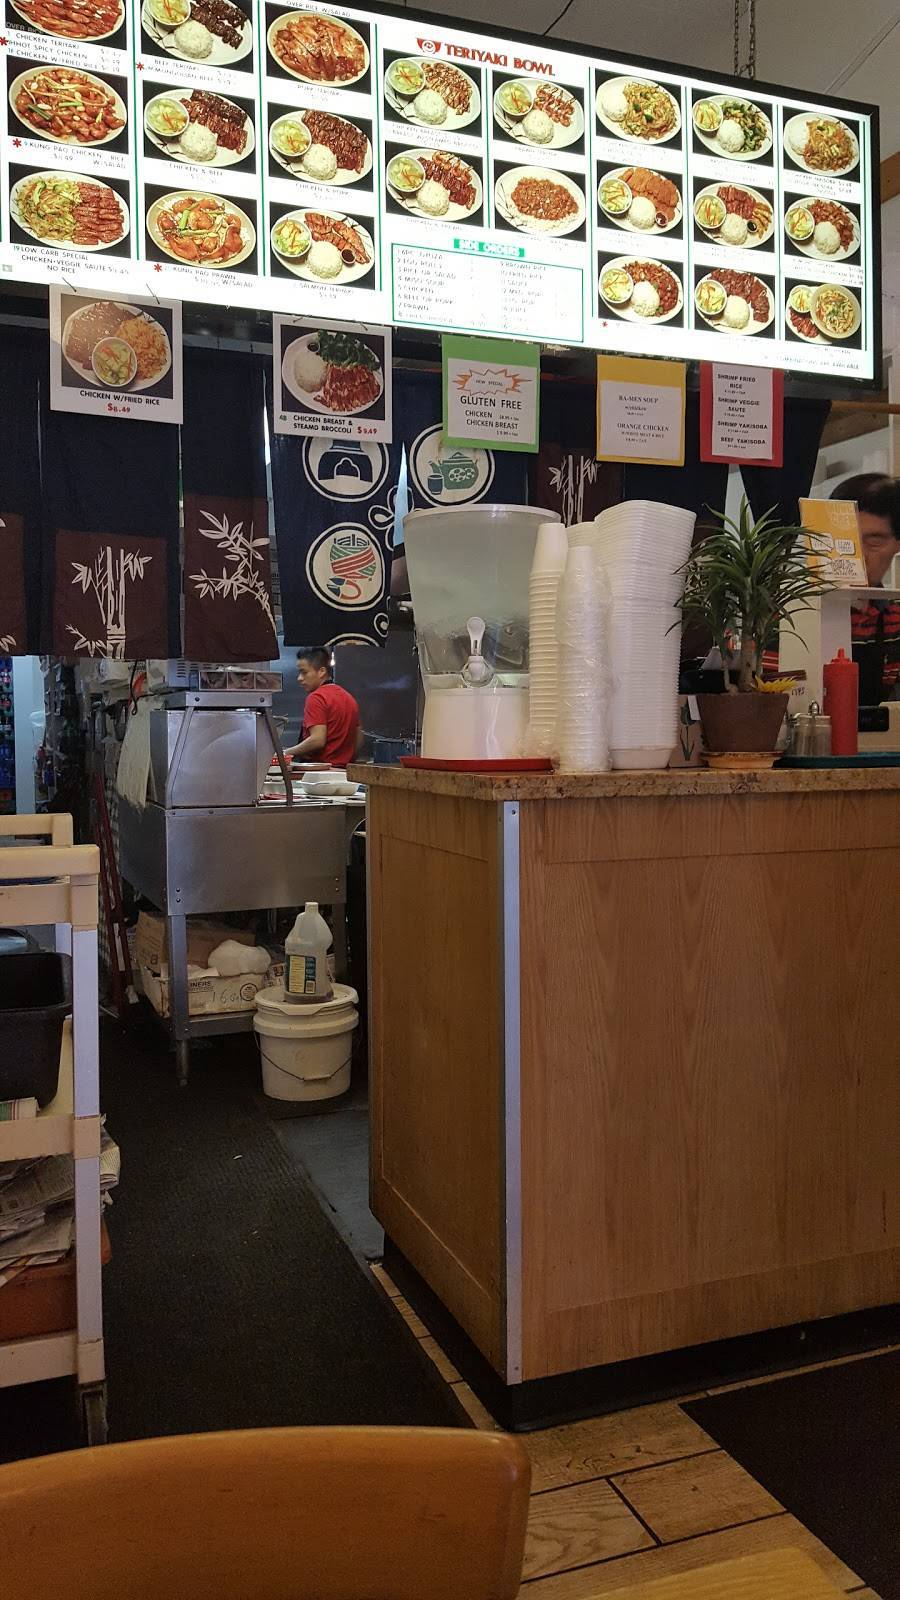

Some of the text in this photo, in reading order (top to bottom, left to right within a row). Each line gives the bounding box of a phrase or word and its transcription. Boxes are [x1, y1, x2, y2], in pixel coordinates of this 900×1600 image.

[16, 32, 48, 43] CHICKEN
[50, 39, 80, 49] TERIYAKI
[16, 50, 48, 60] CHICKEN
[444, 43, 556, 77] TERIYAKI BOWL
[30, 141, 50, 150] KUNG
[21, 245, 38, 253] LOW
[40, 248, 59, 257] CARB
[62, 251, 89, 261] SPECIAL
[46, 264, 58, 272] NO
[717, 373, 738, 381] SHRIMP
[79, 389, 160, 406] CHICKEN W/FRIED RICE
[460, 395, 522, 410] GLUTEN FREE
[465, 409, 493, 418] CHICKEN
[293, 414, 321, 423] CHICKEN
[323, 417, 346, 425] BREAST
[466, 418, 518, 430] CHICKEN BREAST
[321, 425, 352, 434] BROCCOLI
[617, 422, 670, 432] ORANGE CHICKEN
[717, 420, 768, 430] SHRIMP YAKISOBA
